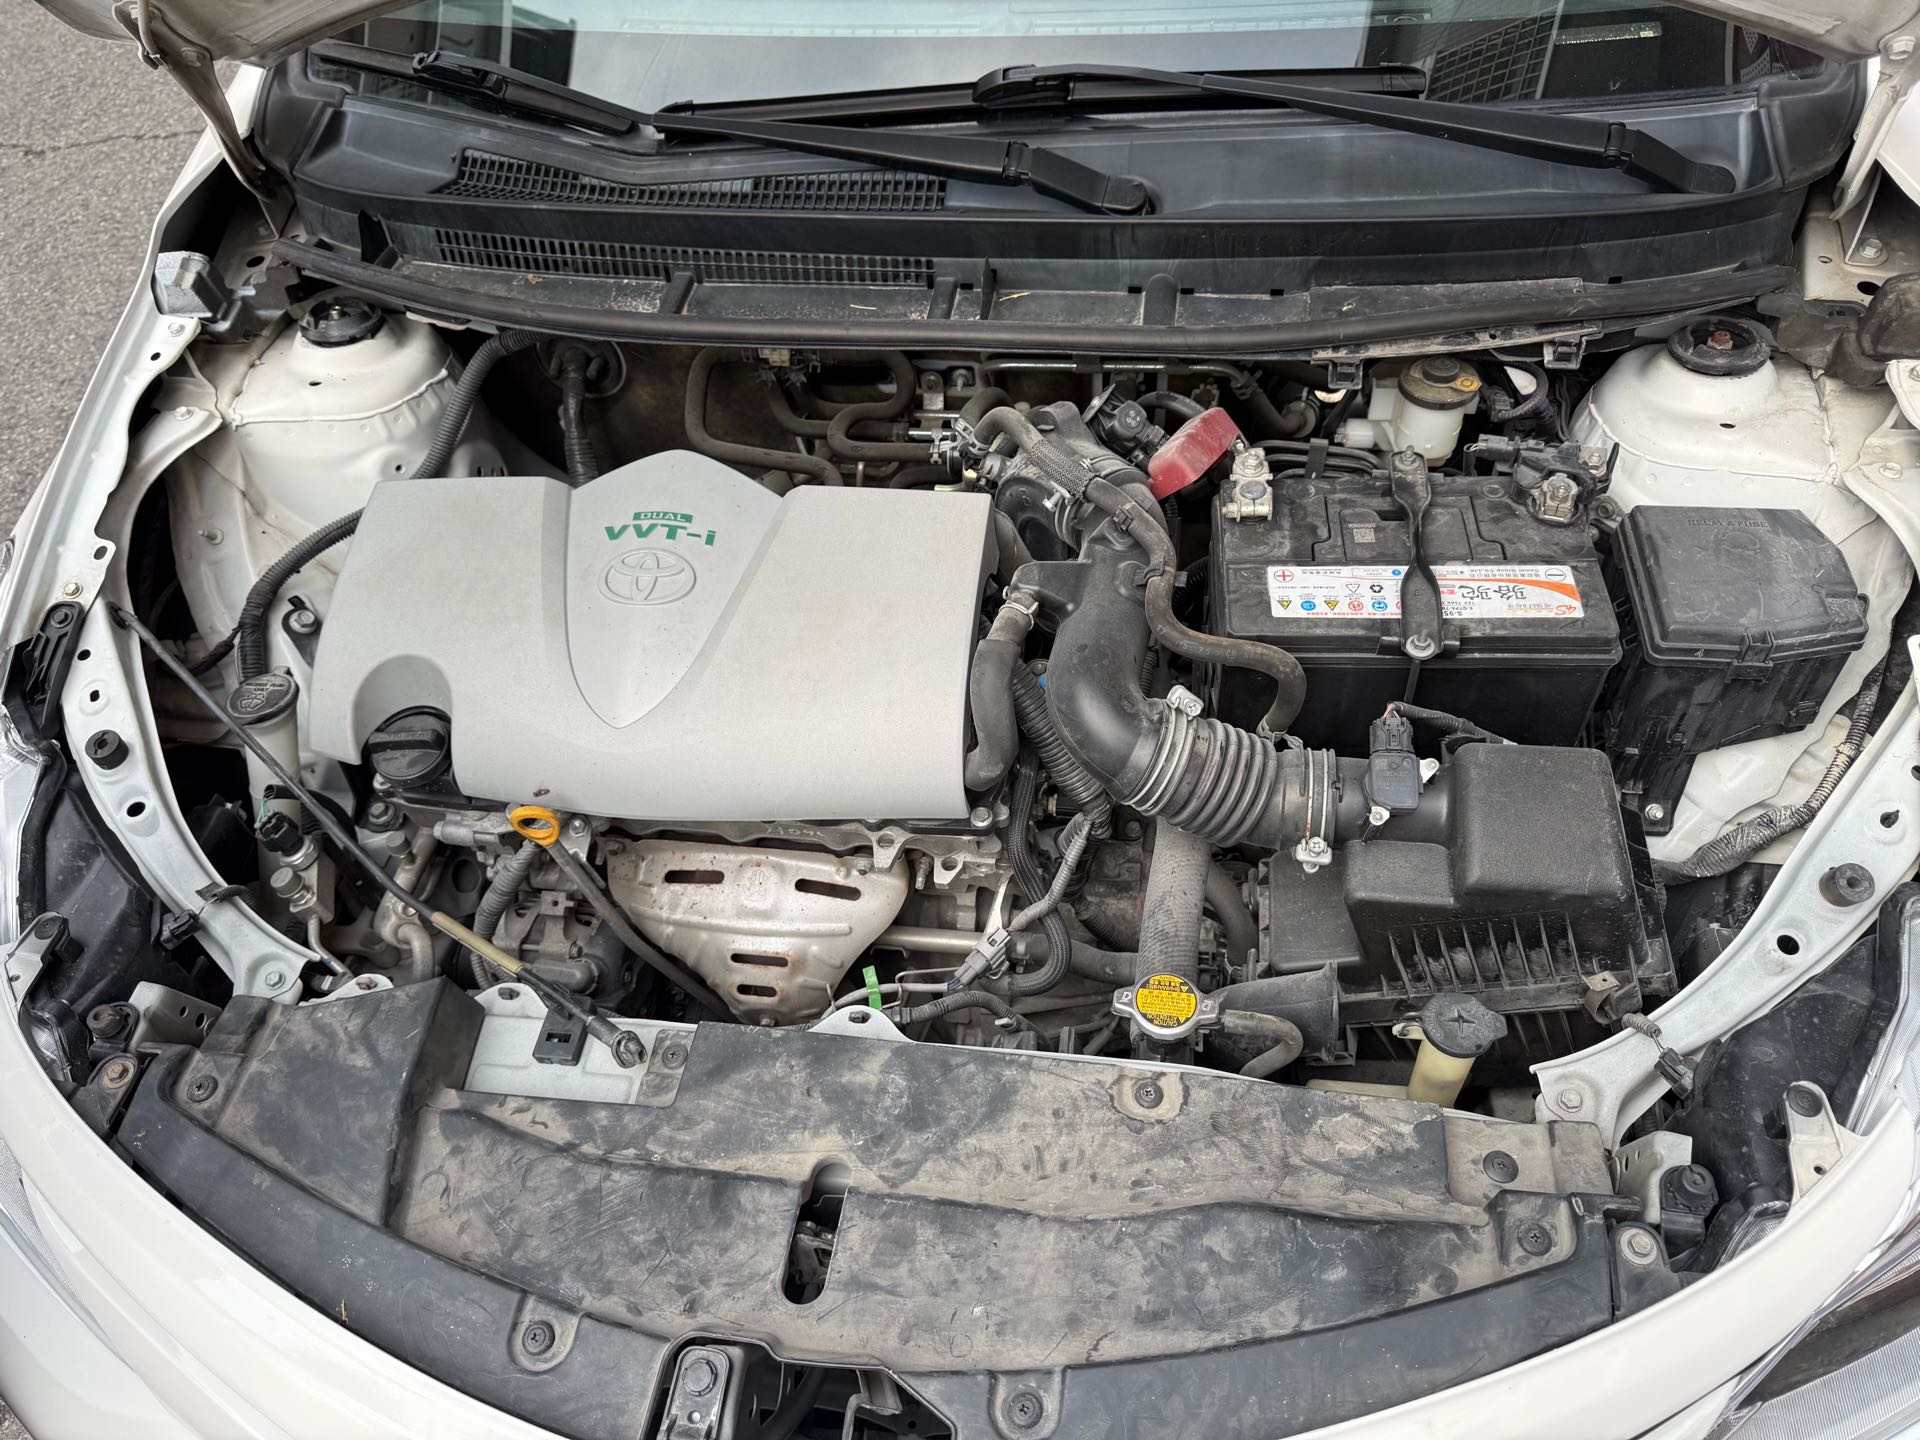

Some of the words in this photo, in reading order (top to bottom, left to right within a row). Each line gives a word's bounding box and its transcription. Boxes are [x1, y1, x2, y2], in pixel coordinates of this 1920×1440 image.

[640, 512, 686, 522] DUAL
[1687, 519, 1724, 527] RELAY
[1737, 520, 1769, 528] FUSE
[604, 523, 717, 546] VVT-i
[1458, 585, 1527, 601] 骆驼
[1555, 604, 1577, 616] 4S
